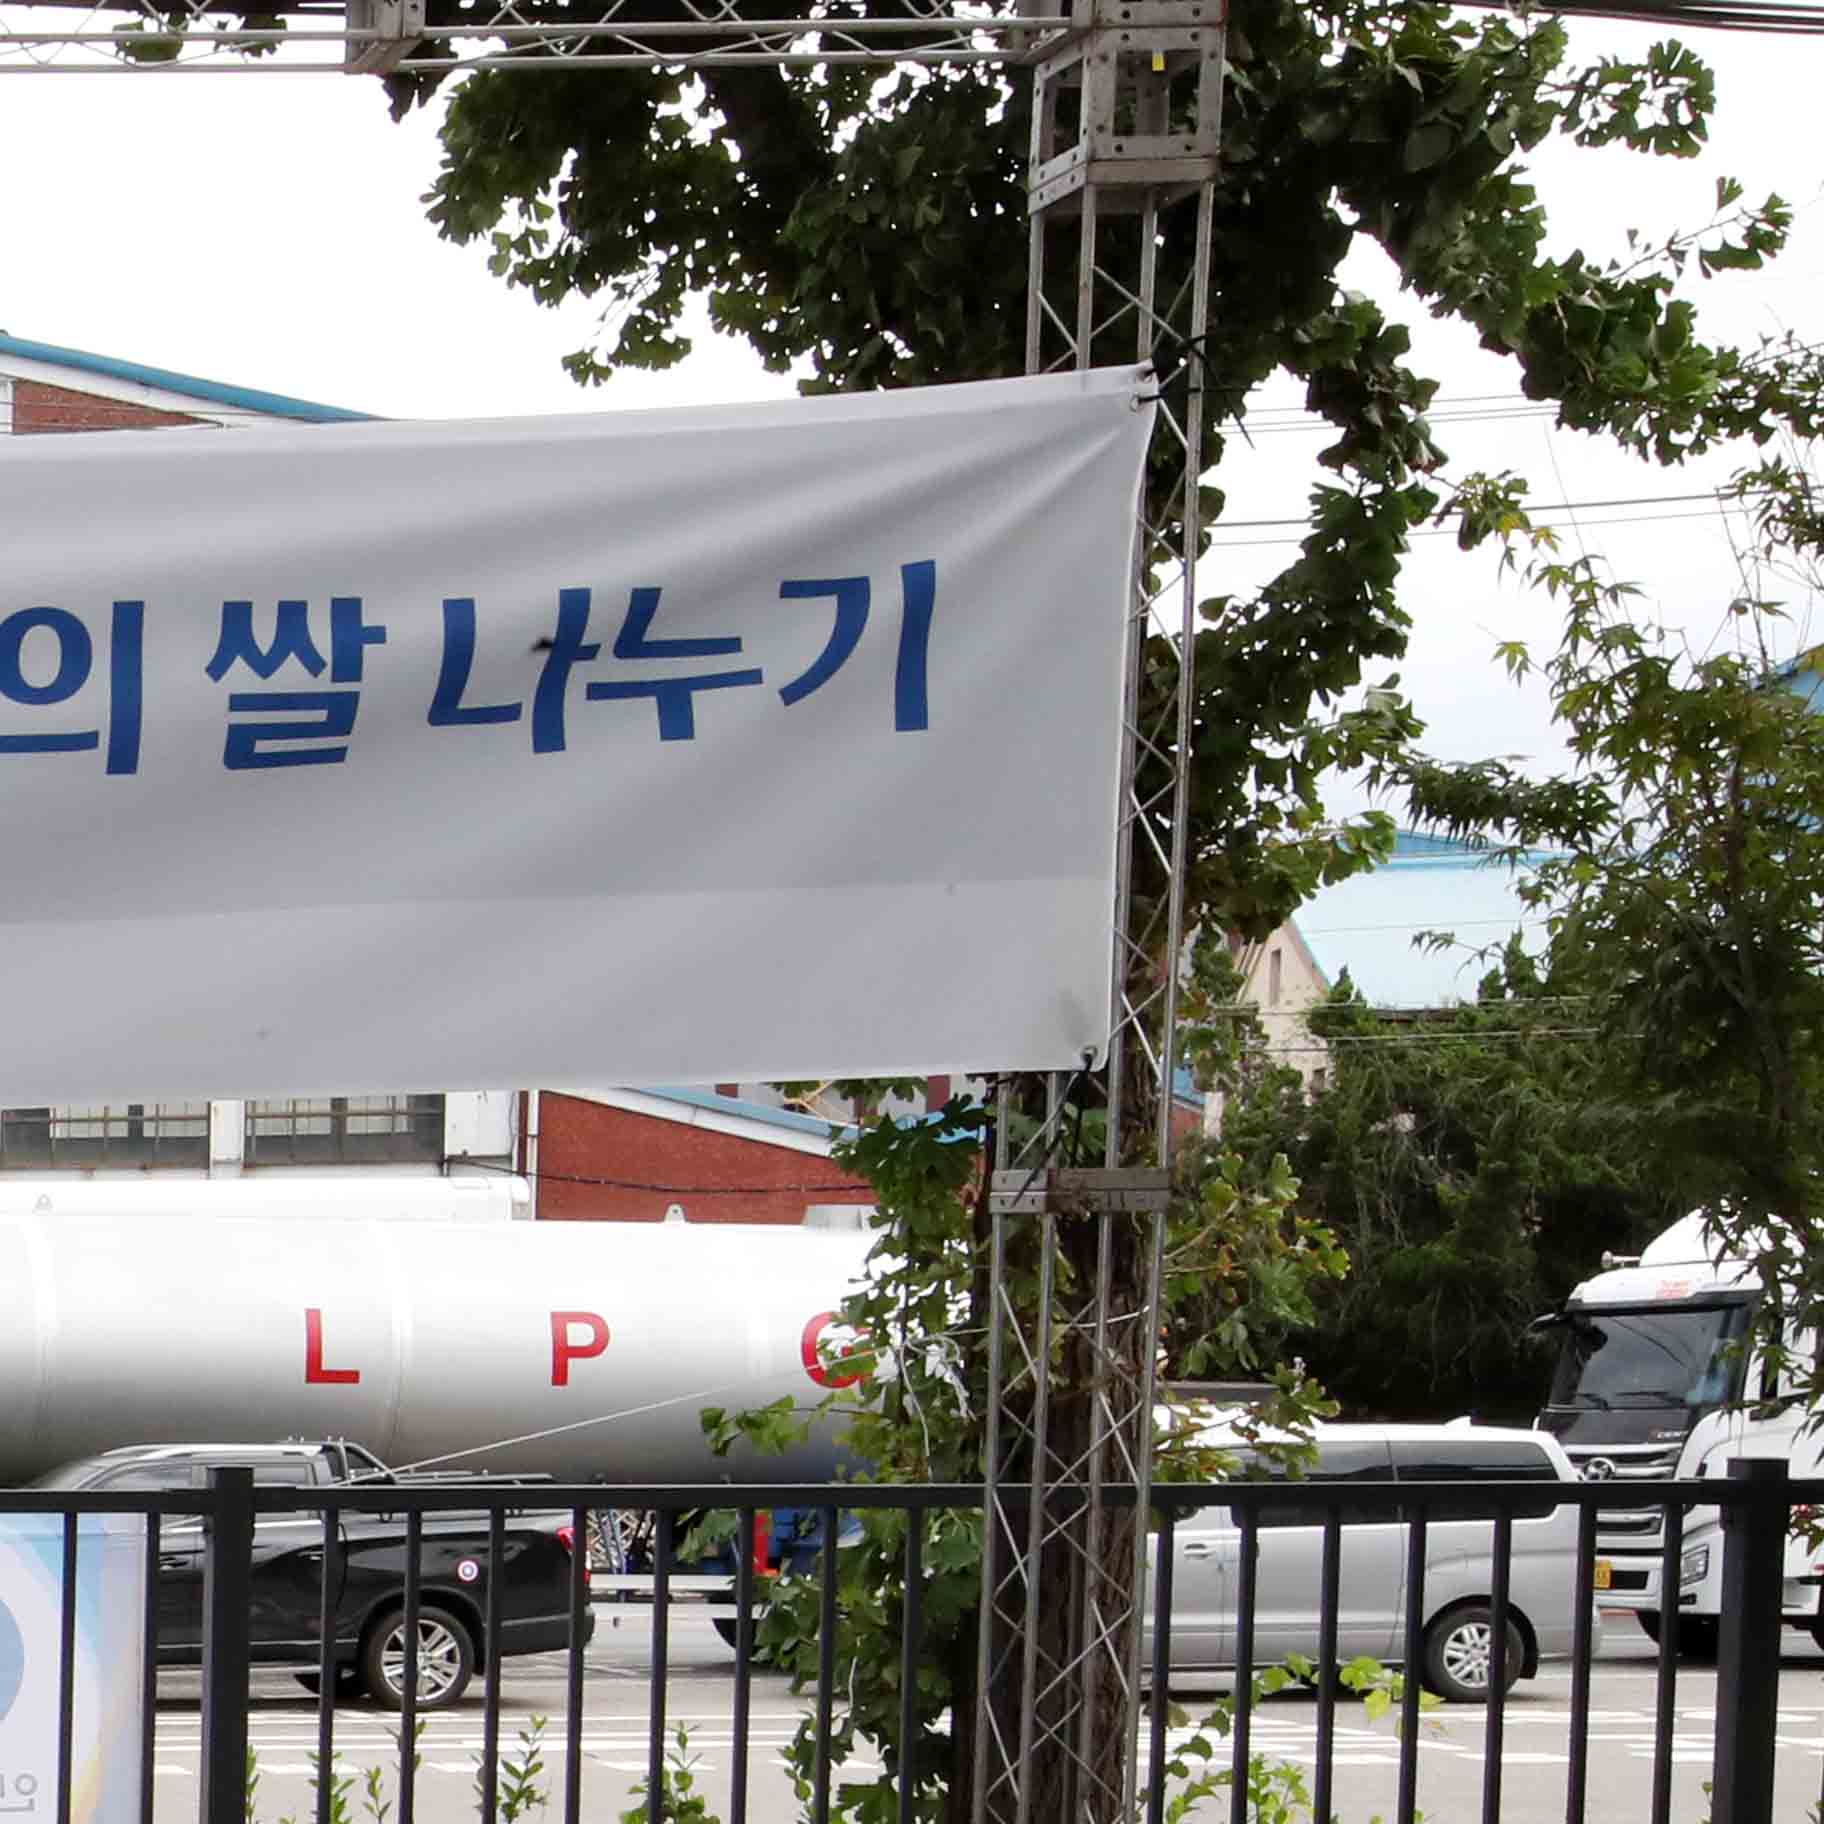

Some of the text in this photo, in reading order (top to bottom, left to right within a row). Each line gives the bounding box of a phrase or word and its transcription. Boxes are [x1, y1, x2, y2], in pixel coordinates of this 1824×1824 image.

[209, 600, 386, 769] 쌀
[433, 560, 936, 754] 나누기
[303, 1307, 361, 1385] L
[551, 1310, 611, 1387] P
